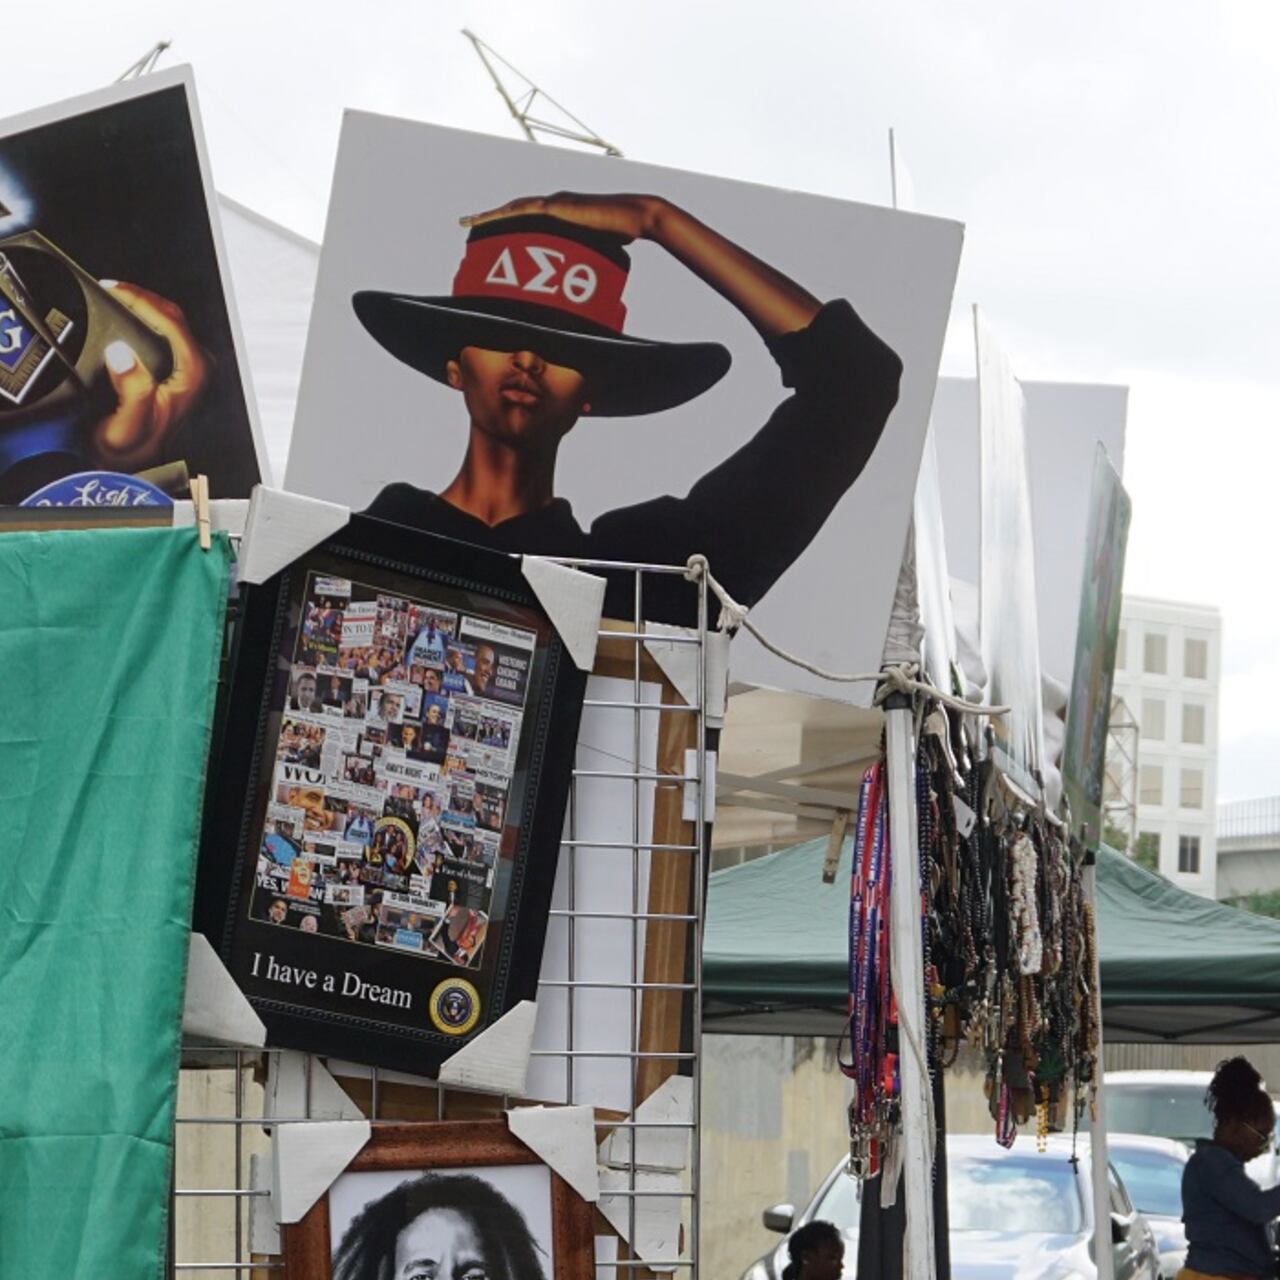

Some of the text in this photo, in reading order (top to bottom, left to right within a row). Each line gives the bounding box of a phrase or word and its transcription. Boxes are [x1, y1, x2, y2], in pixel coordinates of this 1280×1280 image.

[484, 245, 599, 305] ΔΣΘ
[251, 952, 413, 1009] I have a Dream
